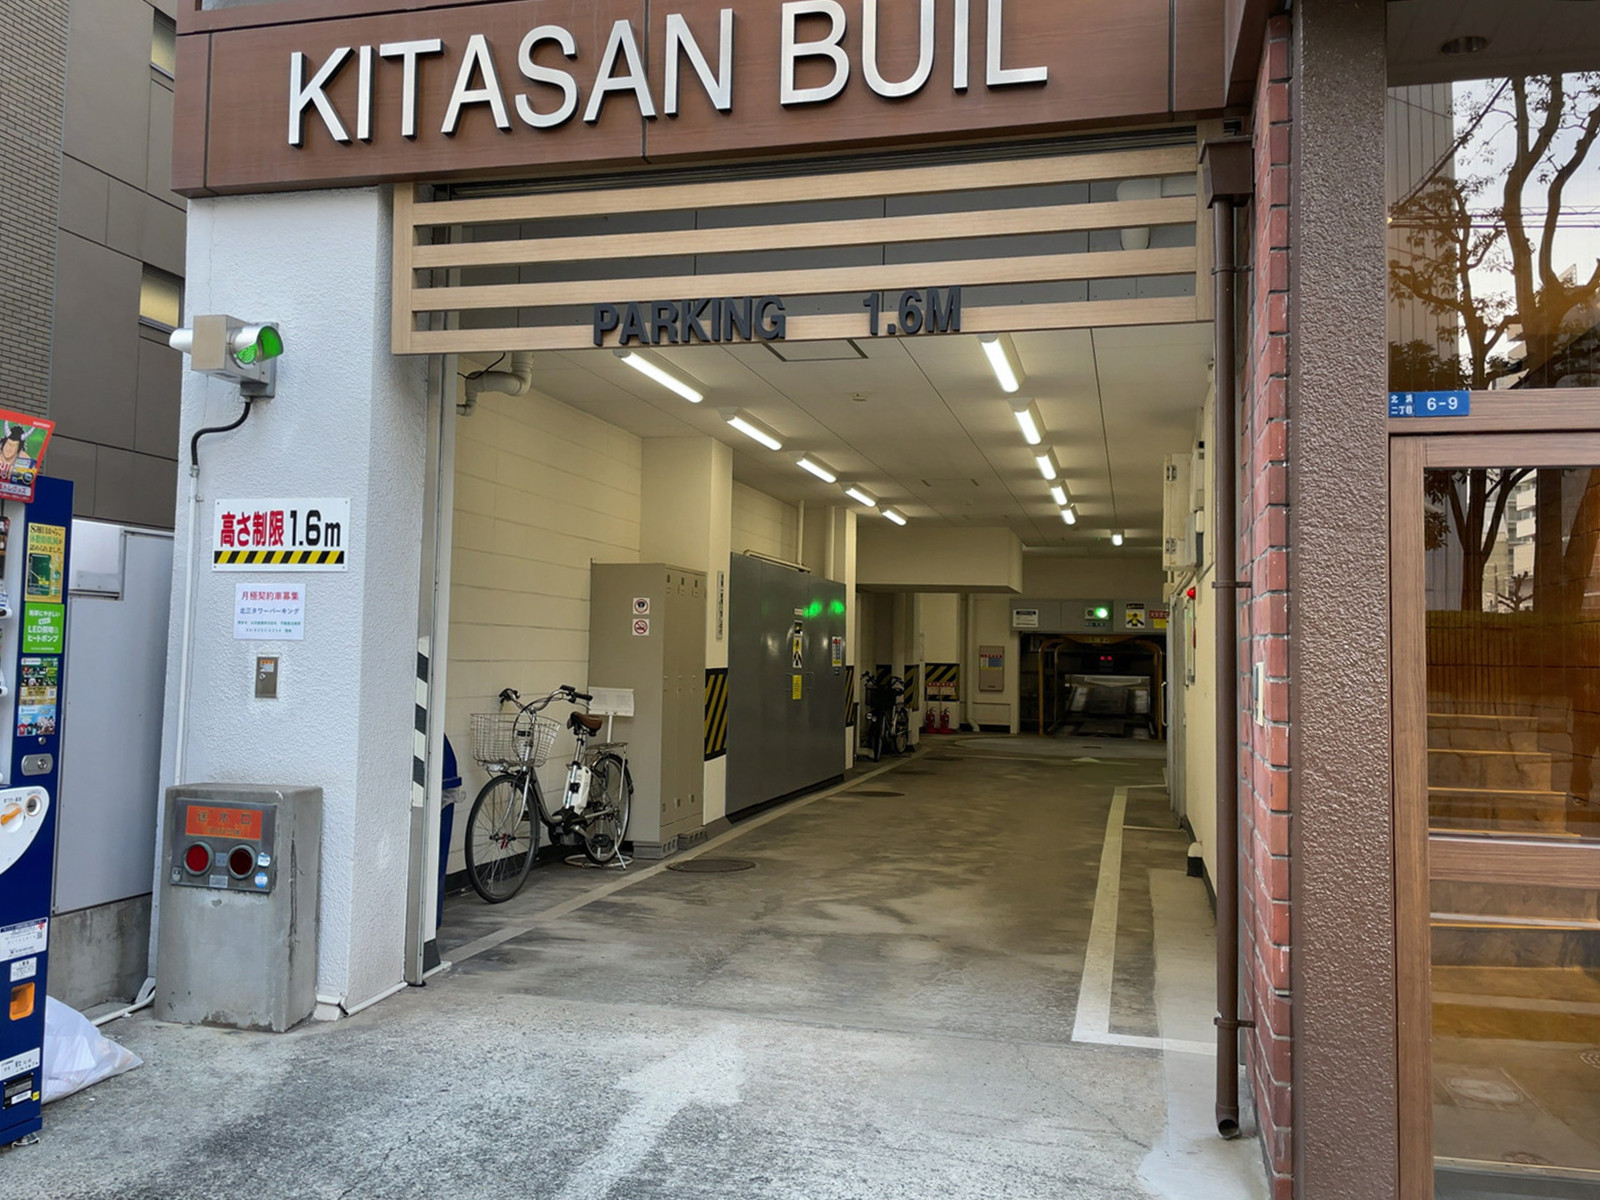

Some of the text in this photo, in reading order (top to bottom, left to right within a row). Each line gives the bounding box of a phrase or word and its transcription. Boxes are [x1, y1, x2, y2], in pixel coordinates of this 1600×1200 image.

[288, 0, 1048, 148] KITASAN BUIL
[593, 286, 961, 346] PARKING 1.6M
[1426, 396, 1458, 411] 6-9
[220, 510, 341, 547] 高さ制限 1.6m
